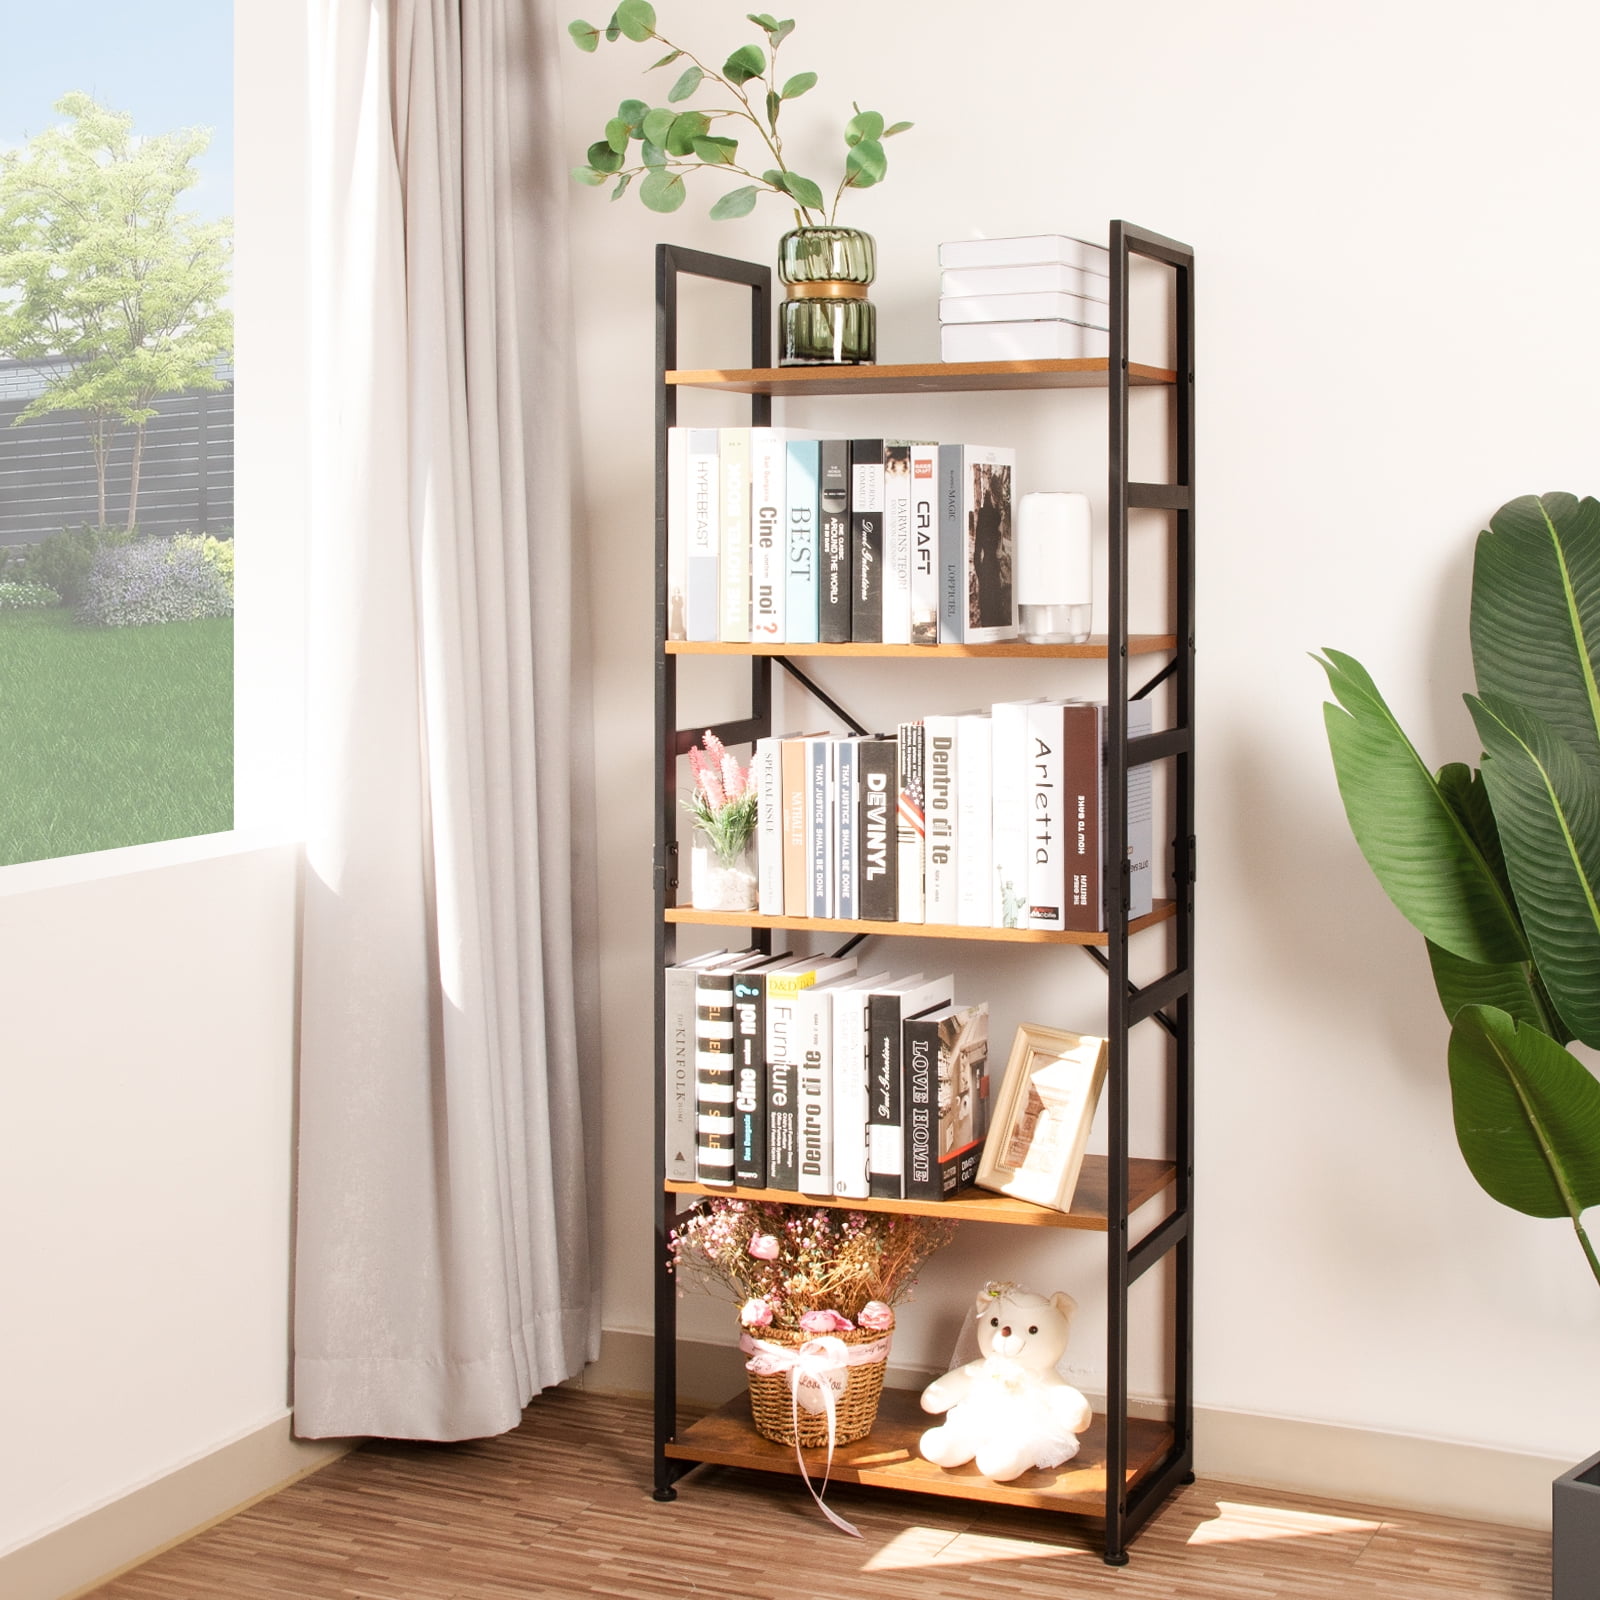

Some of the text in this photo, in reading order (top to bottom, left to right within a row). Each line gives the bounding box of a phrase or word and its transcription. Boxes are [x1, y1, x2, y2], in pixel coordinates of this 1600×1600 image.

[696, 461, 709, 549] HYPEBEAST
[759, 506, 778, 549] Cine
[897, 498, 908, 553] DARWINS
[916, 501, 931, 576] CRAFT
[948, 489, 957, 521] MAGIC
[727, 463, 741, 625] THE HOTEL BOOK
[789, 507, 812, 583] BEST
[829, 517, 838, 604] AROUND THE WORLD
[860, 547, 874, 602] Intentions
[755, 621, 779, 635] ?
[759, 584, 777, 615] noi
[764, 752, 775, 834] SPECIAL ISSUE
[866, 773, 887, 881] DEVINYL
[932, 736, 953, 865] Dentro di te
[1034, 737, 1054, 865] Arletta
[1077, 794, 1086, 855] HOW TO BAKE
[815, 764, 824, 897] THAT JUSTICE SHALL BE DONE
[841, 764, 850, 898] THAT JUSTICE SHALL BE DONE
[1072, 874, 1080, 906] THE GREAT
[1080, 874, 1088, 906] BRITISH
[735, 983, 760, 998] ?
[737, 1003, 756, 1035] noi
[769, 980, 797, 992] D&D
[674, 1028, 687, 1102] KINFOLK
[736, 1069, 757, 1111] Cine
[772, 1006, 793, 1106] Furniture
[875, 1037, 890, 1091] Intentions
[801, 1049, 822, 1176] Dentro di te
[911, 1040, 930, 1183] LOVE HOME
